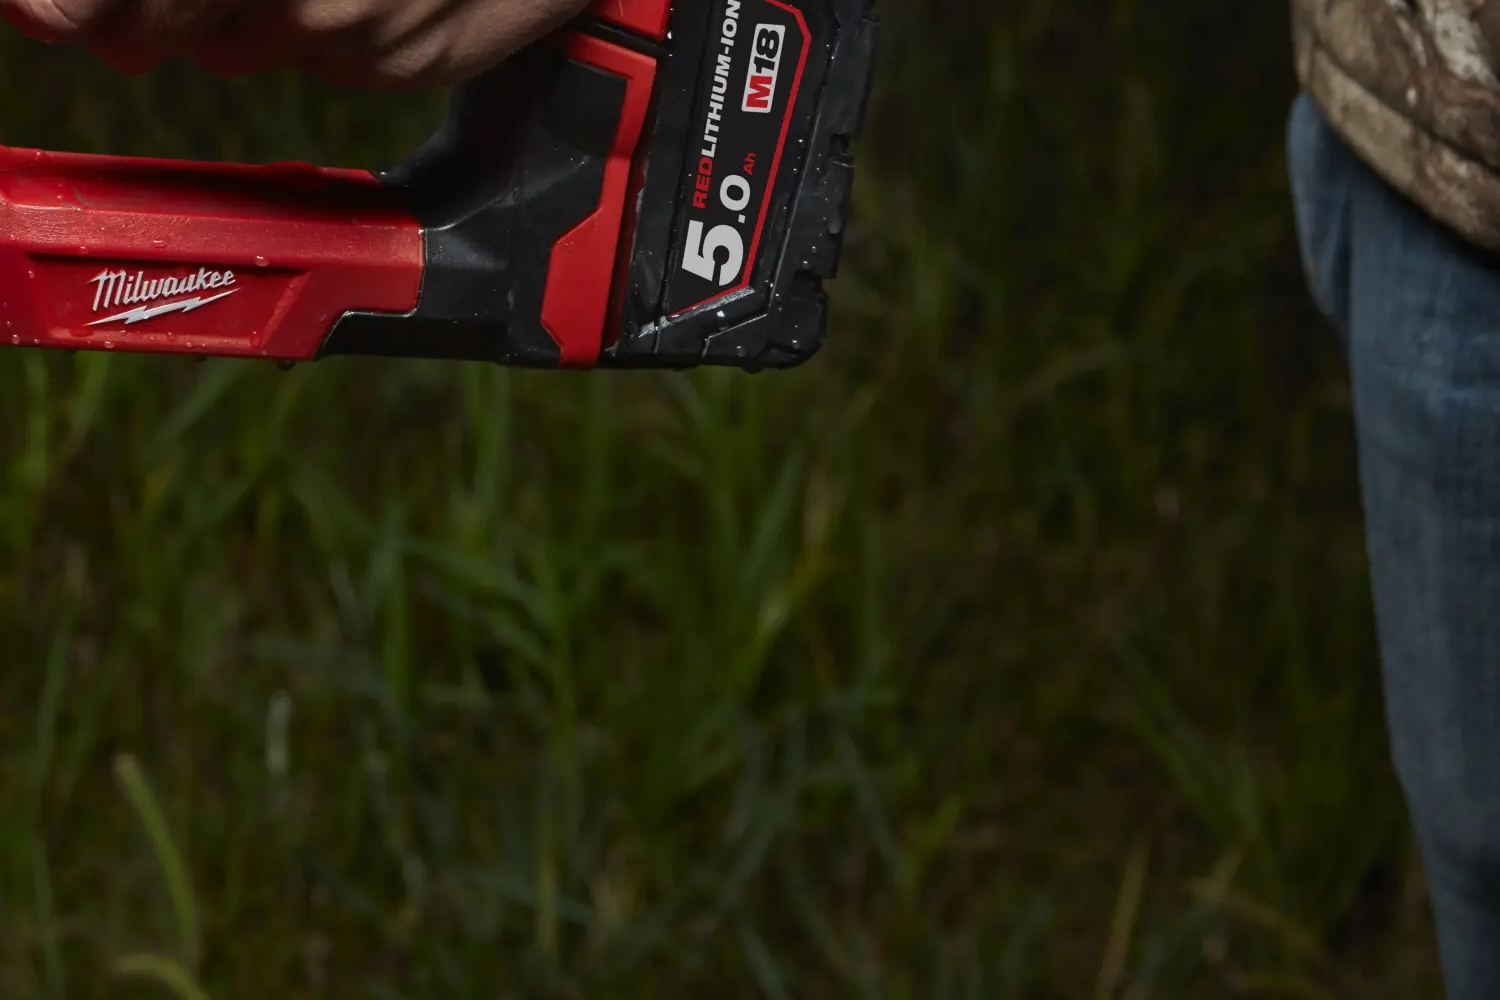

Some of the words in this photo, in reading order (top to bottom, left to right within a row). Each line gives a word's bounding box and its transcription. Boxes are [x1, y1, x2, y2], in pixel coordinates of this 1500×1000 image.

[745, 29, 781, 110] M18
[681, 174, 751, 287] 5.0
[744, 152, 757, 176] Ah
[86, 267, 236, 311] Milwaukee
